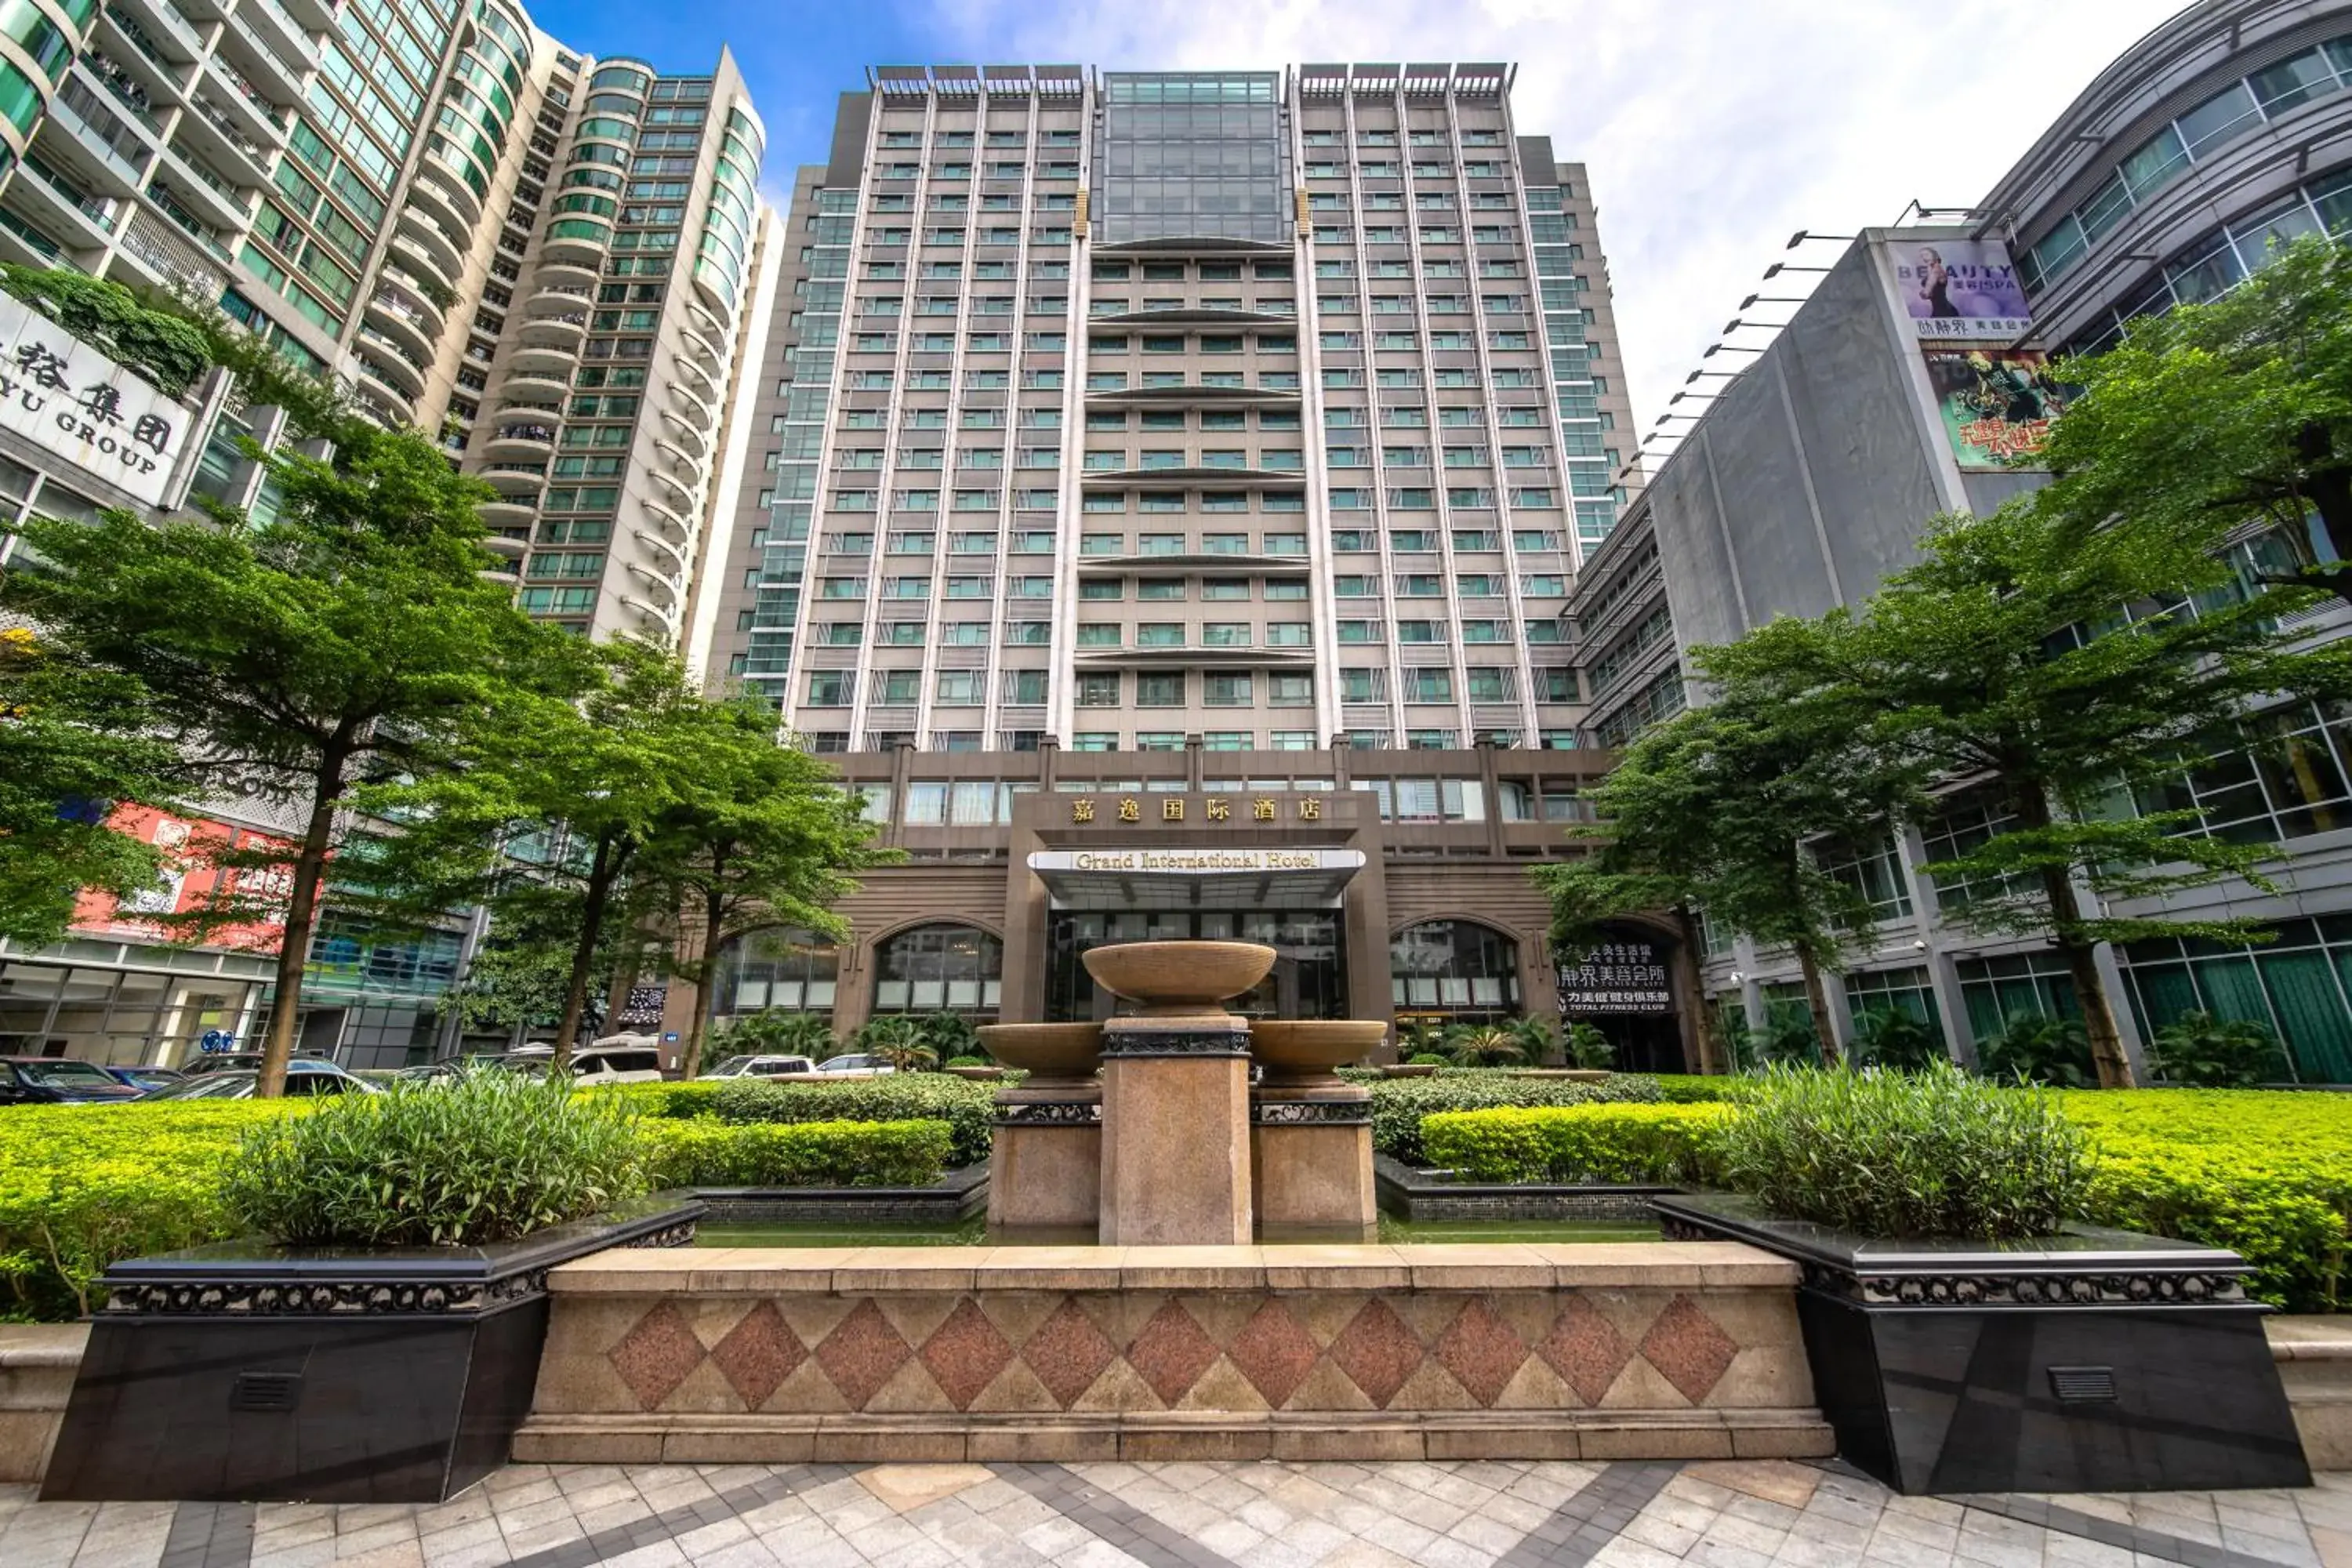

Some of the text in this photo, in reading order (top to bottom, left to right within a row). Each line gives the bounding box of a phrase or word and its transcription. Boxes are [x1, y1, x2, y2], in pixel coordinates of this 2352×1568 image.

[1898, 264, 2012, 279] BEAUTY
[0, 341, 171, 456] 裕集团
[56, 412, 156, 474] GROUP
[1072, 797, 1321, 821] 嘉逸国际酒店
[1076, 851, 1318, 869] Grand International Hotel
